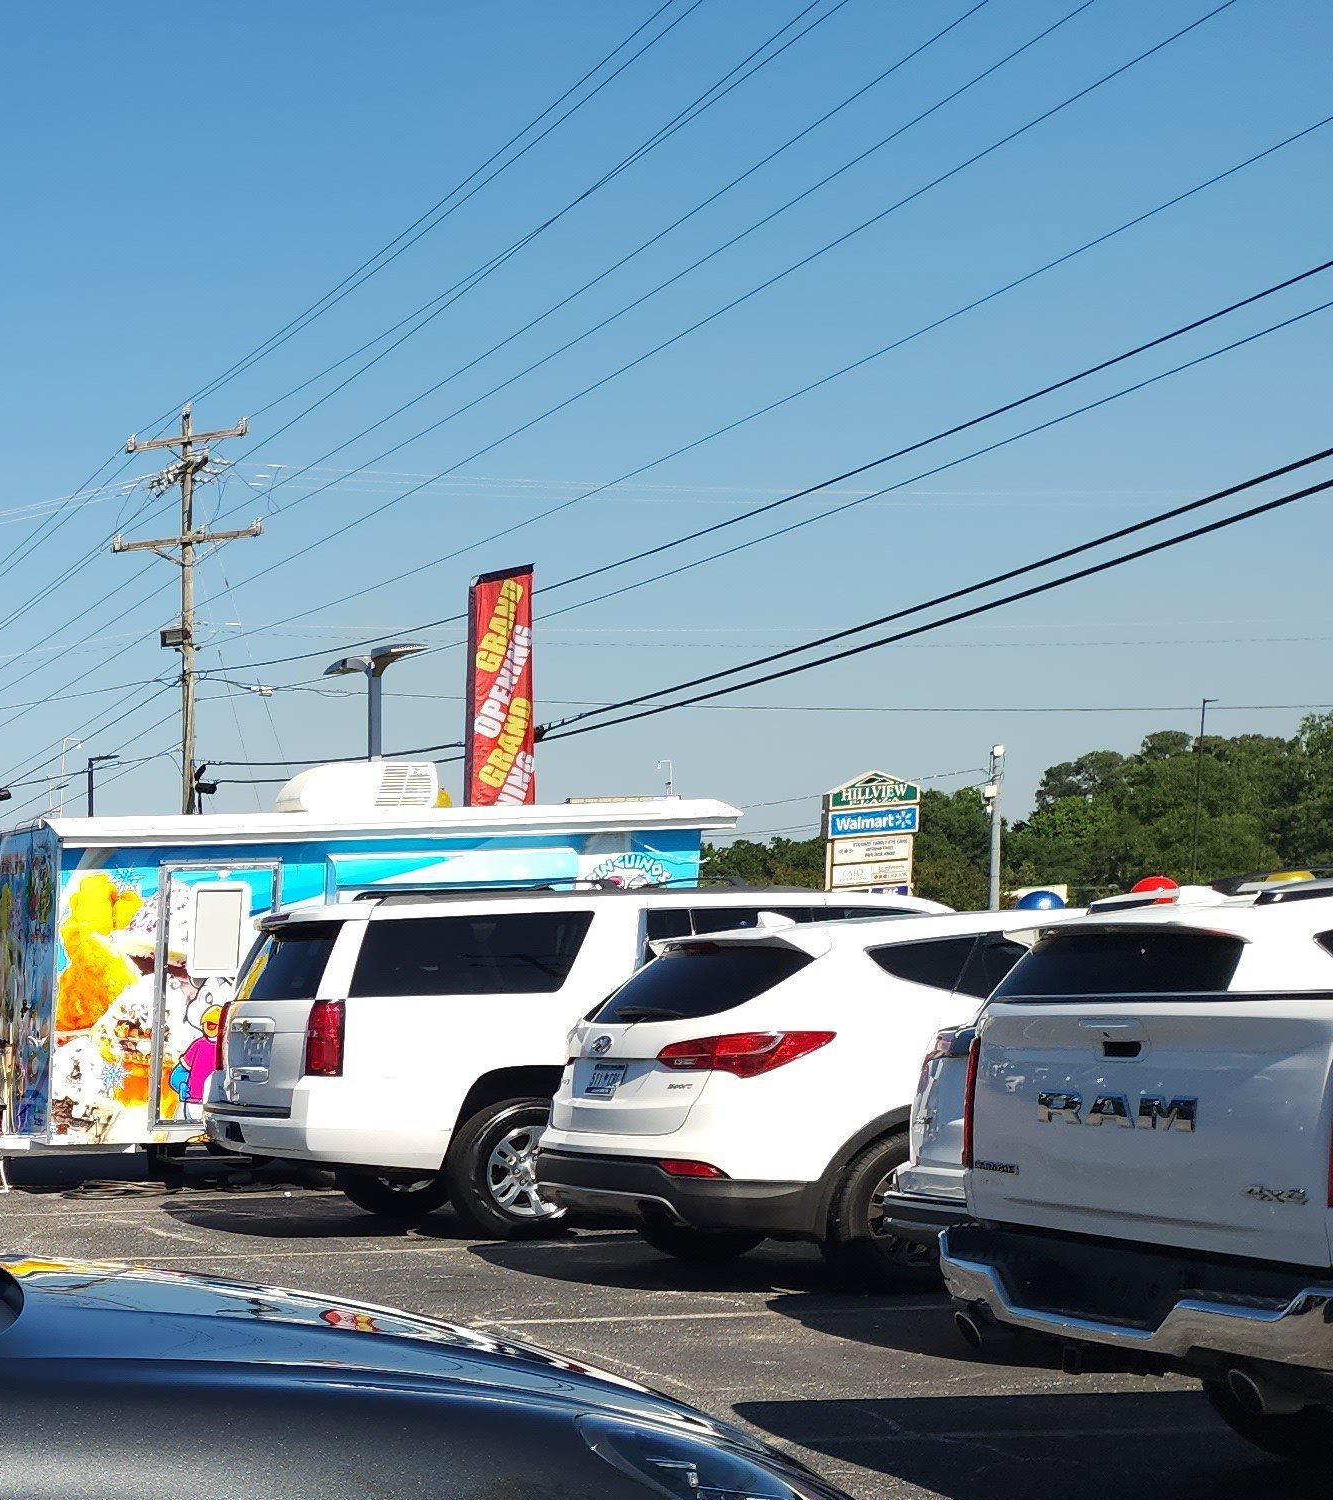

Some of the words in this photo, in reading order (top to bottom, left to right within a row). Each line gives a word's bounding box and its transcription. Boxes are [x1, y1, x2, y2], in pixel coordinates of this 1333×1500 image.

[476, 578, 523, 673] GRAND
[474, 625, 532, 739] OPENING
[478, 697, 531, 788] GRAND
[494, 750, 535, 806] NING
[841, 782, 907, 801] HILLVIEW
[836, 813, 894, 832] Walmart
[1037, 1089, 1199, 1133] RAM
